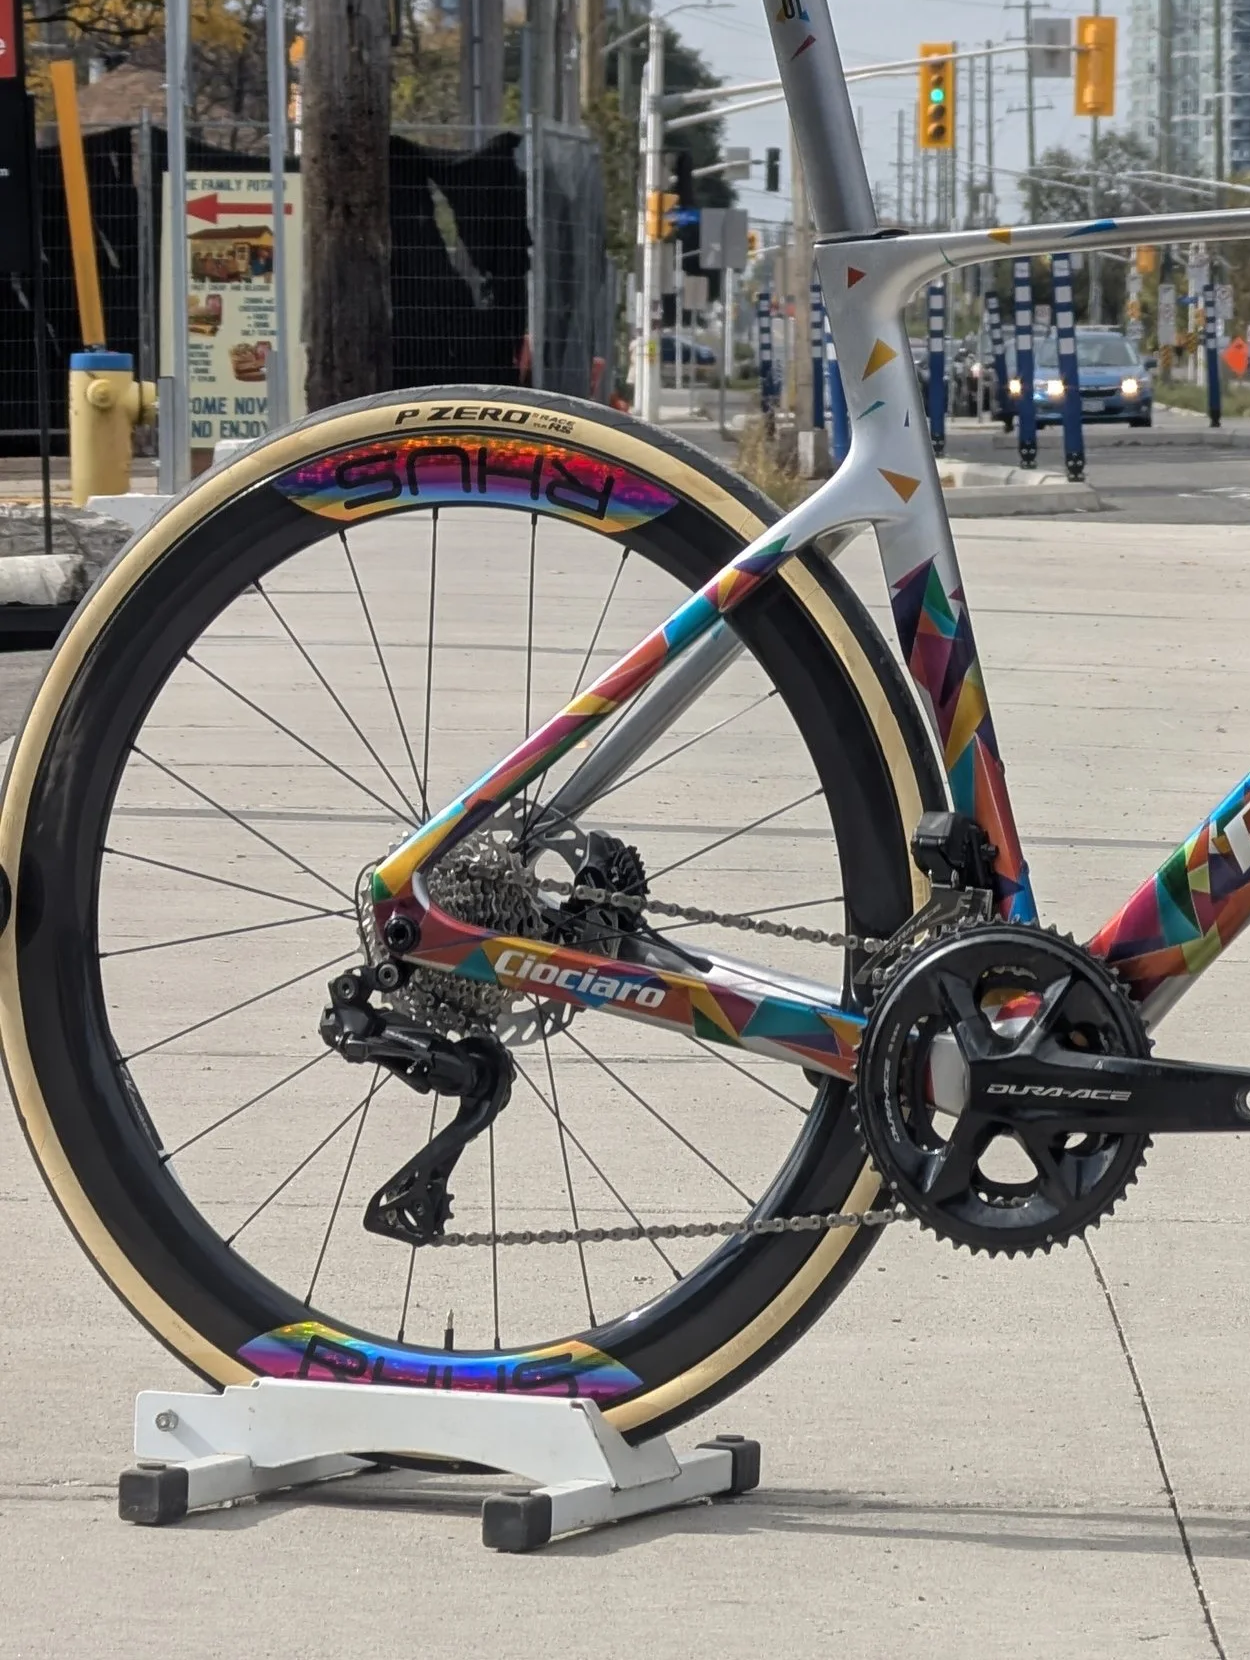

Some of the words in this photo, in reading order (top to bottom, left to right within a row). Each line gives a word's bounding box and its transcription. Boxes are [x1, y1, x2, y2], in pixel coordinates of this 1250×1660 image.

[201, 179, 242, 190] FAMILY
[189, 396, 228, 415] OME
[394, 408, 420, 425] P
[427, 406, 532, 424] ZERO
[191, 420, 213, 439] ND
[334, 445, 616, 521] RHUS
[494, 949, 666, 1009] Ciociaro
[986, 1083, 1132, 1102] DURA-ACE
